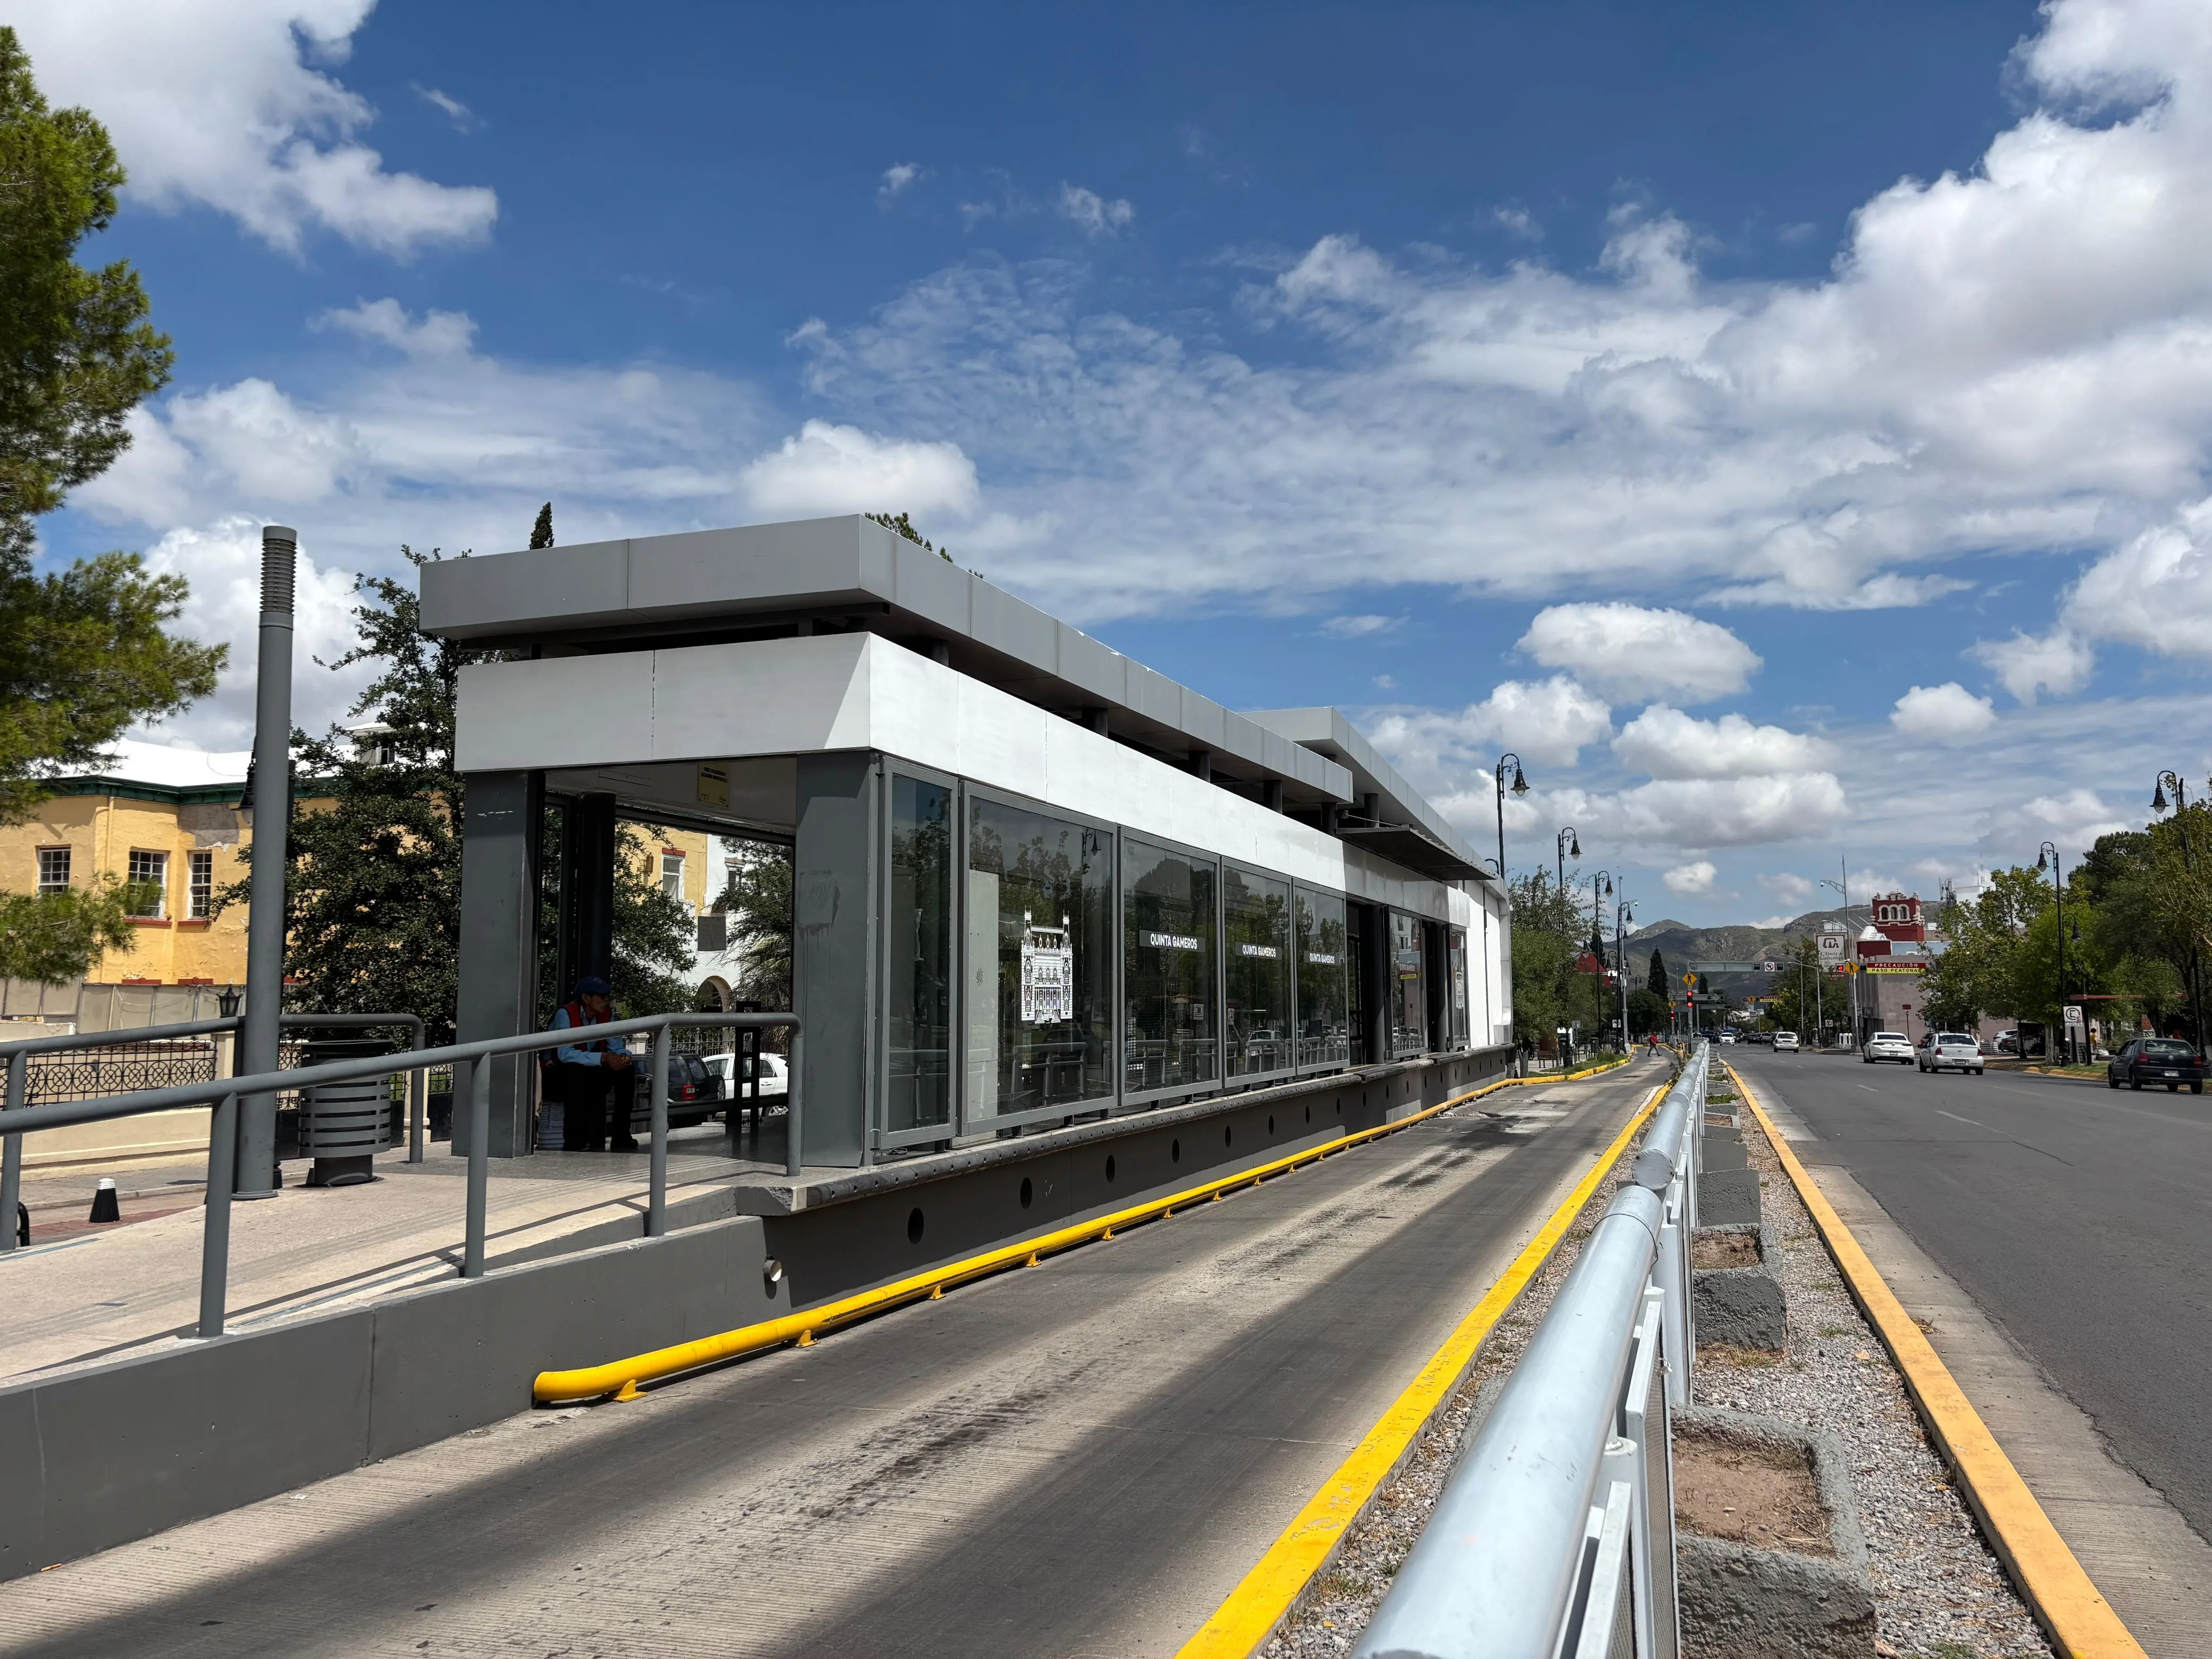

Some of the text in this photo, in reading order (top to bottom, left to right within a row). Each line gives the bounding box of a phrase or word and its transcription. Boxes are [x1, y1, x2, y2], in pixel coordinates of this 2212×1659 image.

[1151, 933, 1197, 950] QUINTA GAMEROS
[1243, 944, 1276, 958] QUINTA GAMEROS
[1310, 953, 1321, 962] QUINTA
